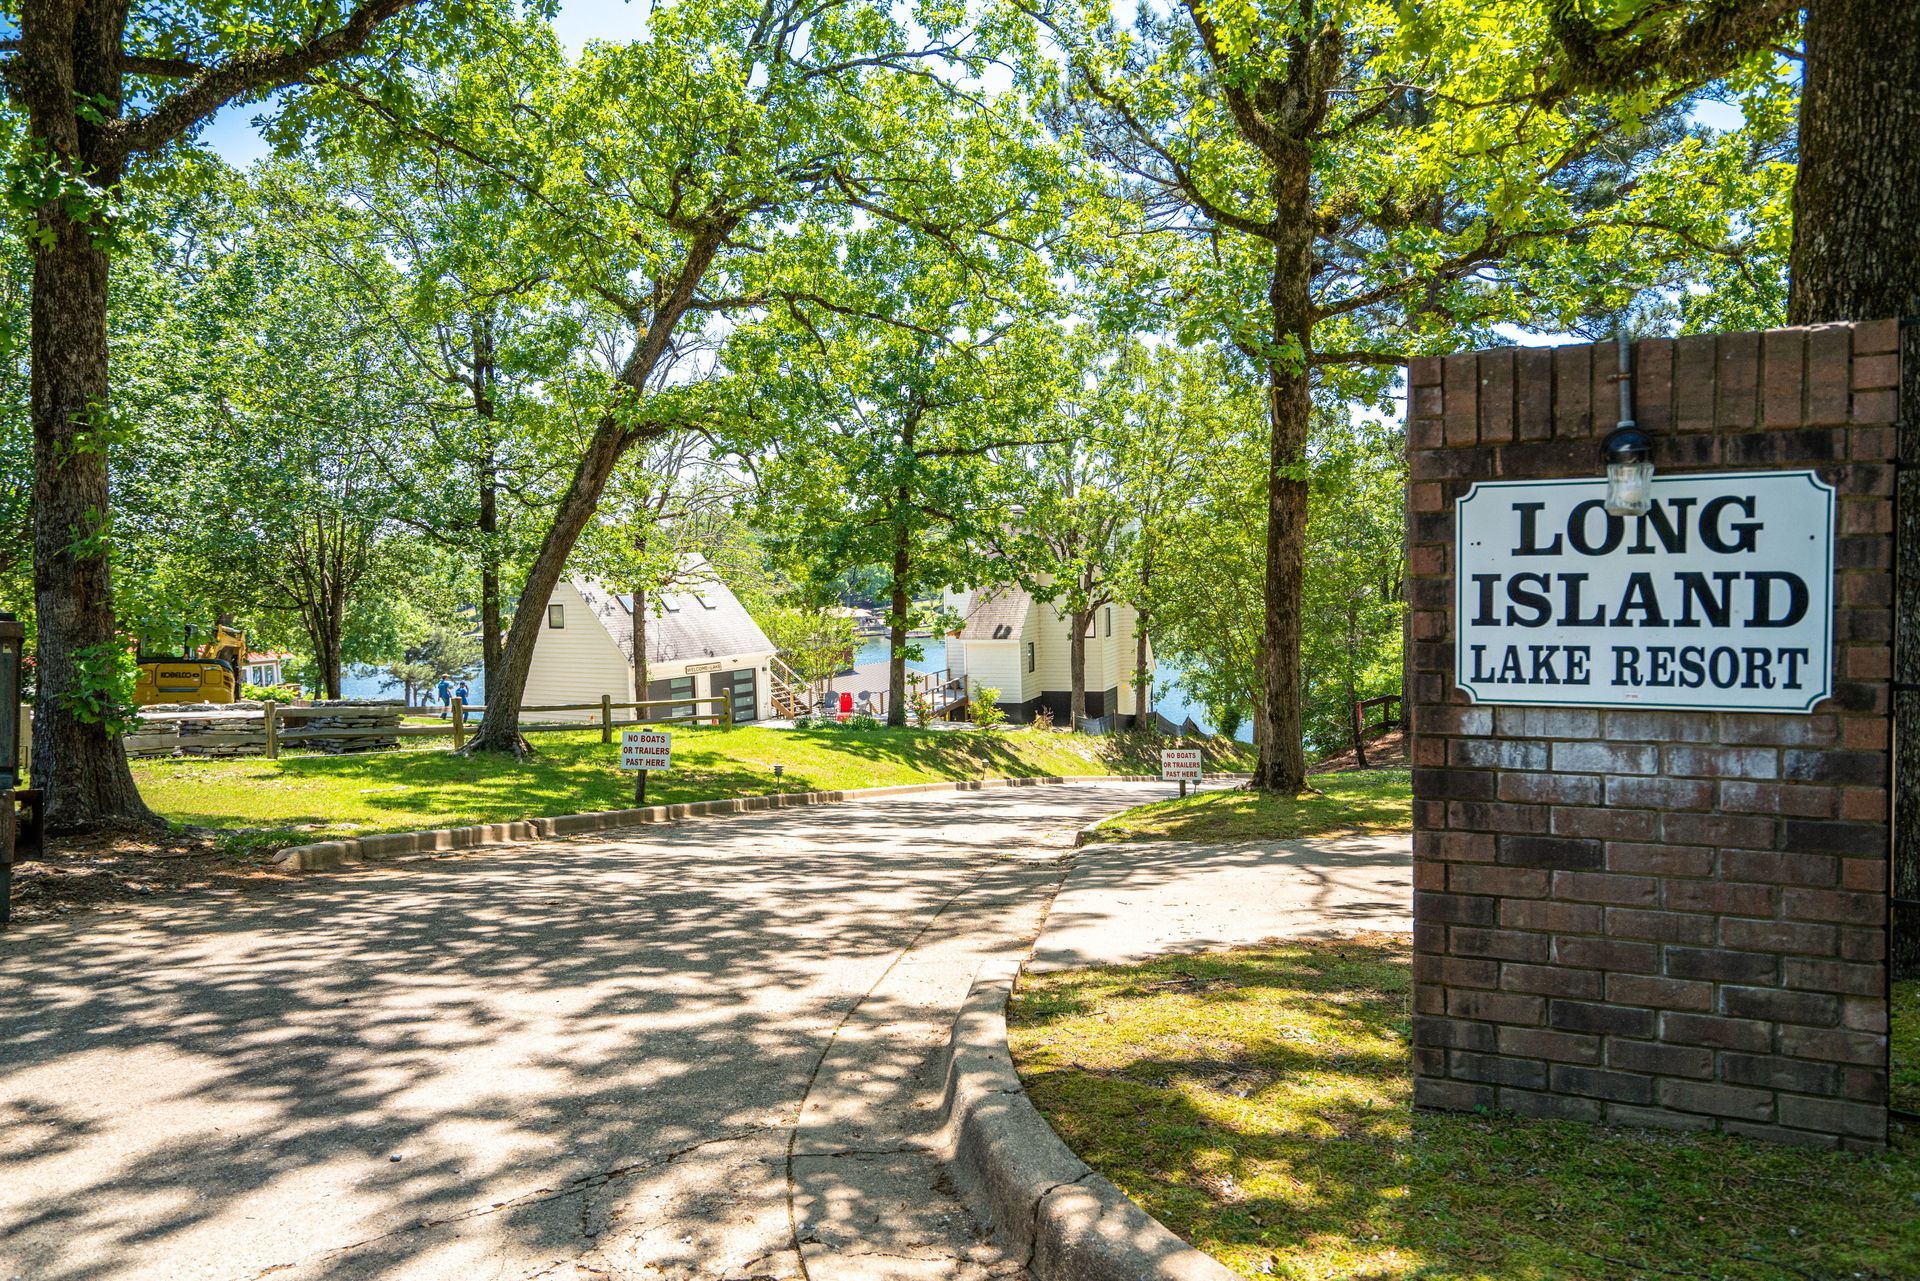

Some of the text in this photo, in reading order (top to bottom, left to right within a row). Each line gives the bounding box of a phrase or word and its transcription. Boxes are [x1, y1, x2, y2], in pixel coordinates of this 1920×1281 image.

[1511, 495, 1764, 557] LONG
[1470, 570, 1810, 629] ISLAND
[1470, 644, 1809, 690] LAKE RESORT
[635, 747, 670, 755] TRAILERS
[641, 735, 665, 743] BOATS
